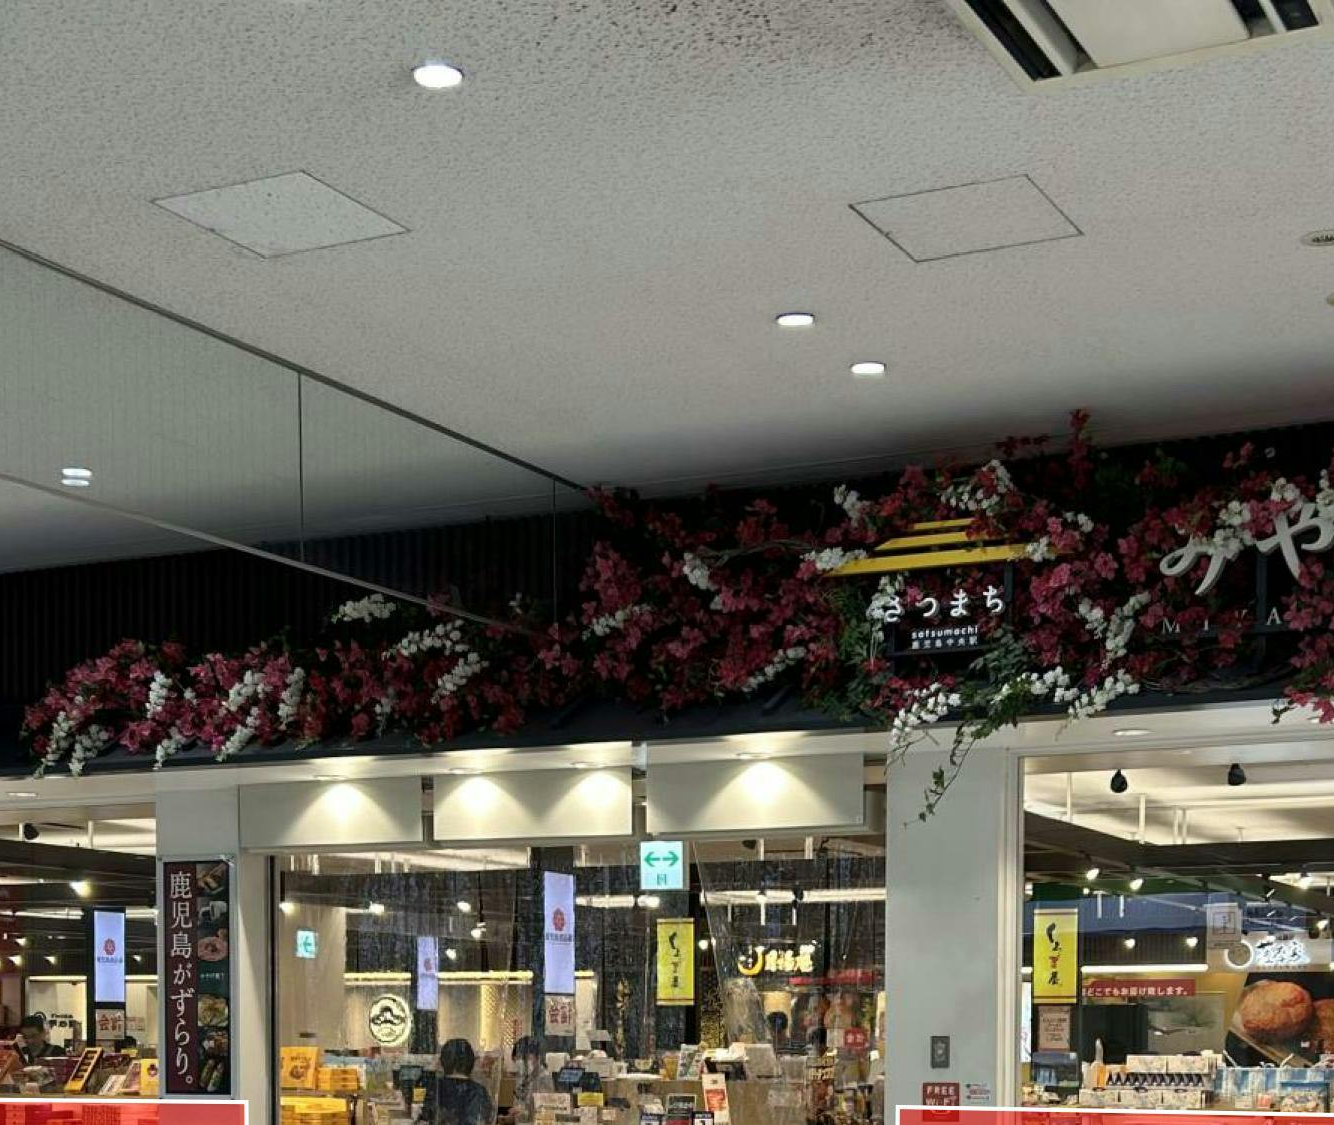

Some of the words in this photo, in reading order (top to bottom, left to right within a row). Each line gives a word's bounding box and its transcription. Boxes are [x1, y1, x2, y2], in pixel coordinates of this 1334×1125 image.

[884, 585, 1004, 623] さつまち
[911, 625, 978, 640] satsumachi
[170, 870, 196, 1084] 鹿児島がずらり。
[927, 1085, 955, 1096] FREE
